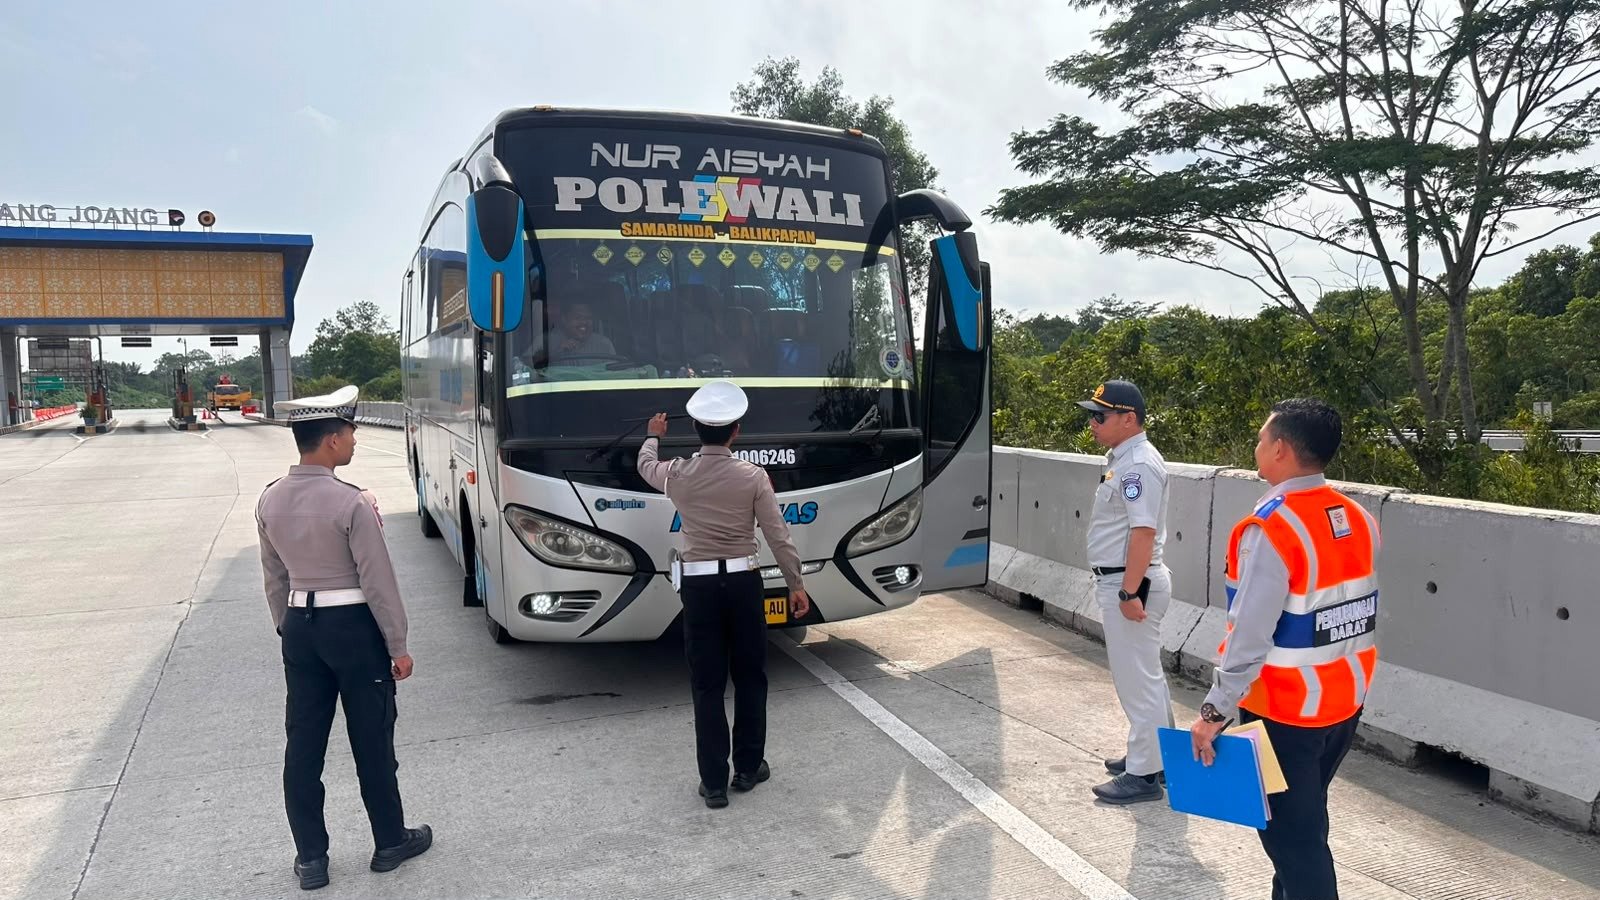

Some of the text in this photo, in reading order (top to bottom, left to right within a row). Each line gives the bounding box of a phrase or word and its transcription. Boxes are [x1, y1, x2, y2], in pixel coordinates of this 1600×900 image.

[590, 142, 830, 181] NUR AISYAH
[553, 176, 865, 227] POLEWALI
[68, 205, 158, 226] JOANG
[620, 222, 716, 239] SAMARINDA
[729, 226, 817, 244] BALIKPAPAN
[764, 600, 785, 616] AU
[1329, 618, 1368, 642] DARAT
